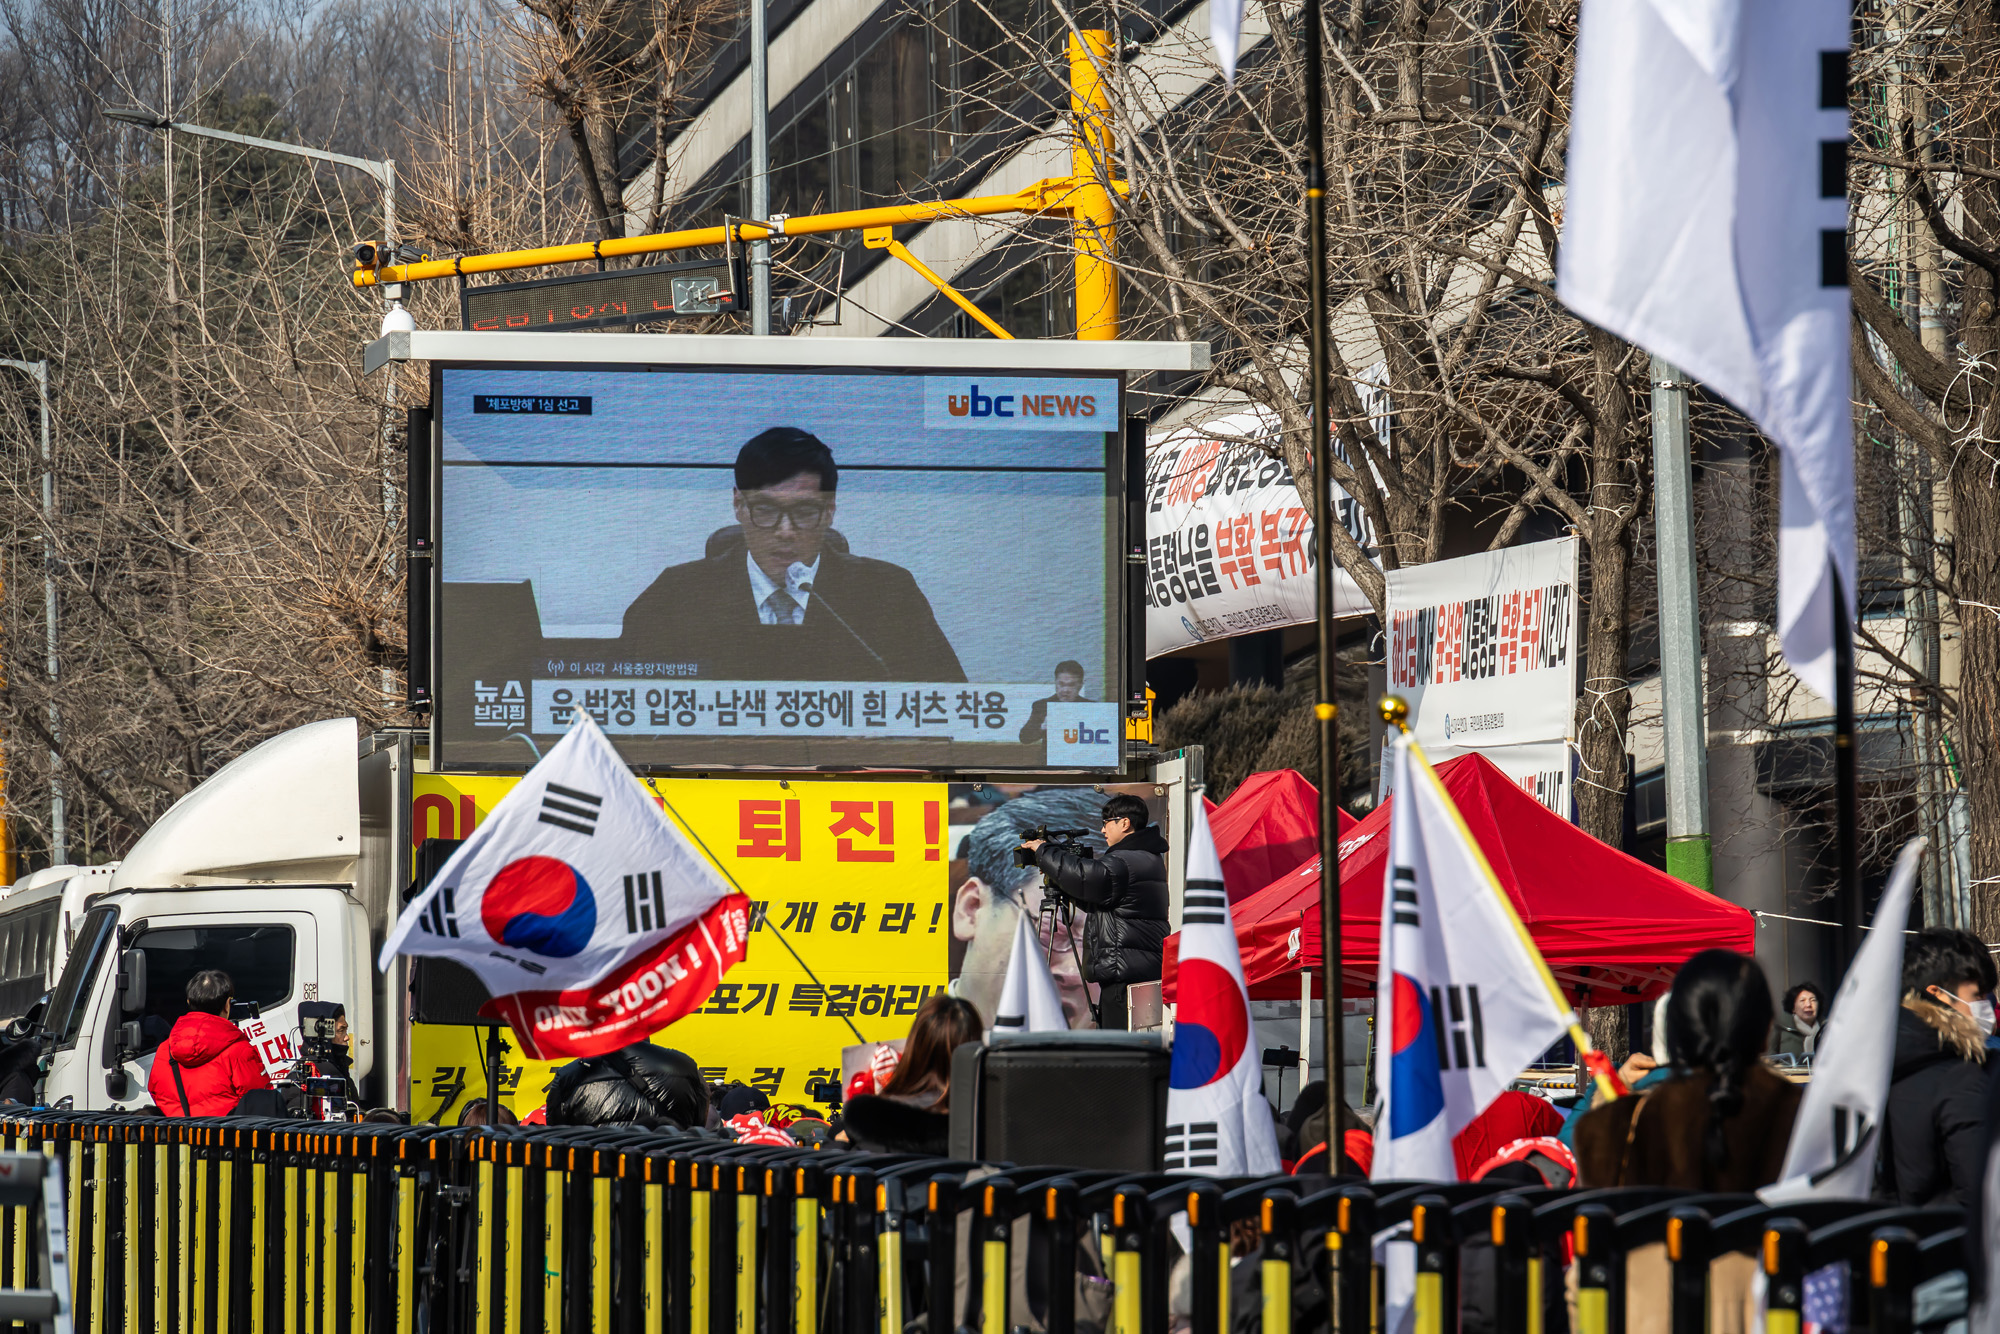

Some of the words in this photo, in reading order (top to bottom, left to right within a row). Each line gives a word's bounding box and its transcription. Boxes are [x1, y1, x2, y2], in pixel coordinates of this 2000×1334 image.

[538, 398, 554, 412] 1심
[557, 398, 580, 412] 선고
[948, 385, 1014, 417] ubc
[1022, 394, 1096, 416] NEWS
[1216, 512, 1262, 590] 부활
[1500, 589, 1521, 676] 부활
[570, 662, 581, 675] 이
[584, 662, 605, 675] 시각
[612, 662, 698, 676] 서울중앙지방법원
[474, 680, 525, 703] 뉴스
[474, 704, 525, 721] 브리핑
[549, 688, 576, 725] 윤
[585, 688, 636, 726] 법정
[775, 689, 854, 728] 정장에
[863, 690, 887, 727] 흰
[896, 690, 949, 728] 셔츠
[956, 691, 1009, 729] 착용
[1064, 722, 1110, 745] ubc
[304, 983, 317, 992] CCP
[304, 992, 317, 1000] OUT
